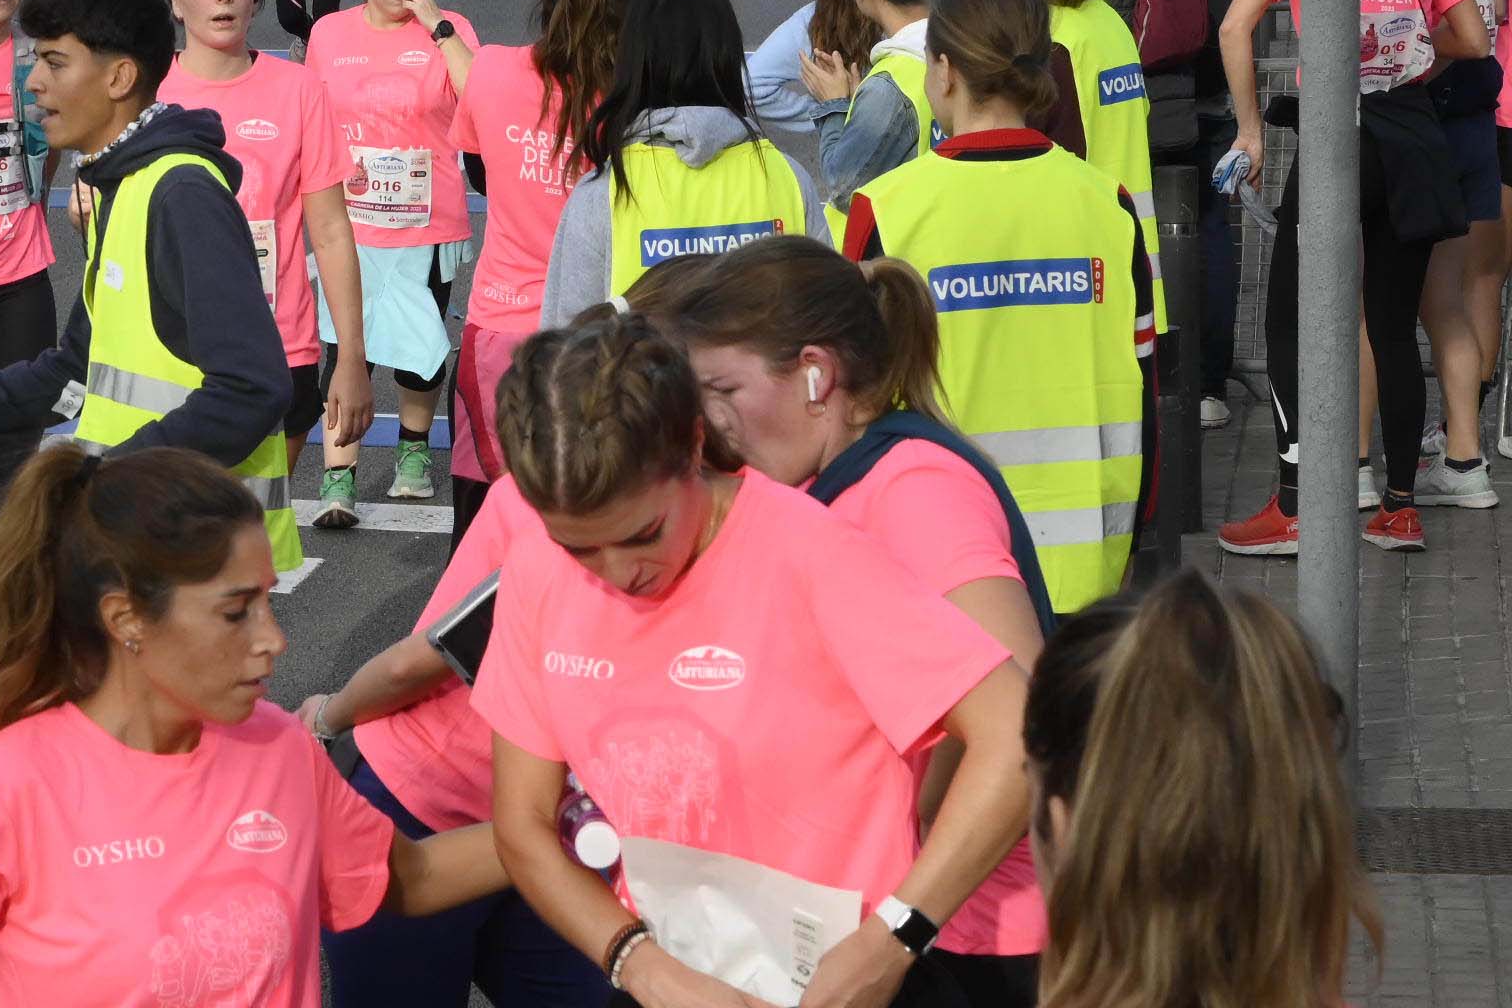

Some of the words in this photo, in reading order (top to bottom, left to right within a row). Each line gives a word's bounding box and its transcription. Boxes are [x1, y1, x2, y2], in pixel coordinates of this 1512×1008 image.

[524, 147, 550, 167] DE
[371, 179, 402, 192] 016
[519, 164, 574, 189] MUJE
[350, 201, 375, 210] CARRERA
[379, 195, 393, 203] 114
[932, 270, 1089, 299] VOLUNTARIS
[544, 651, 615, 680] OYSHO
[672, 663, 743, 680] ASTURIANA
[73, 837, 166, 869] OYSHO
